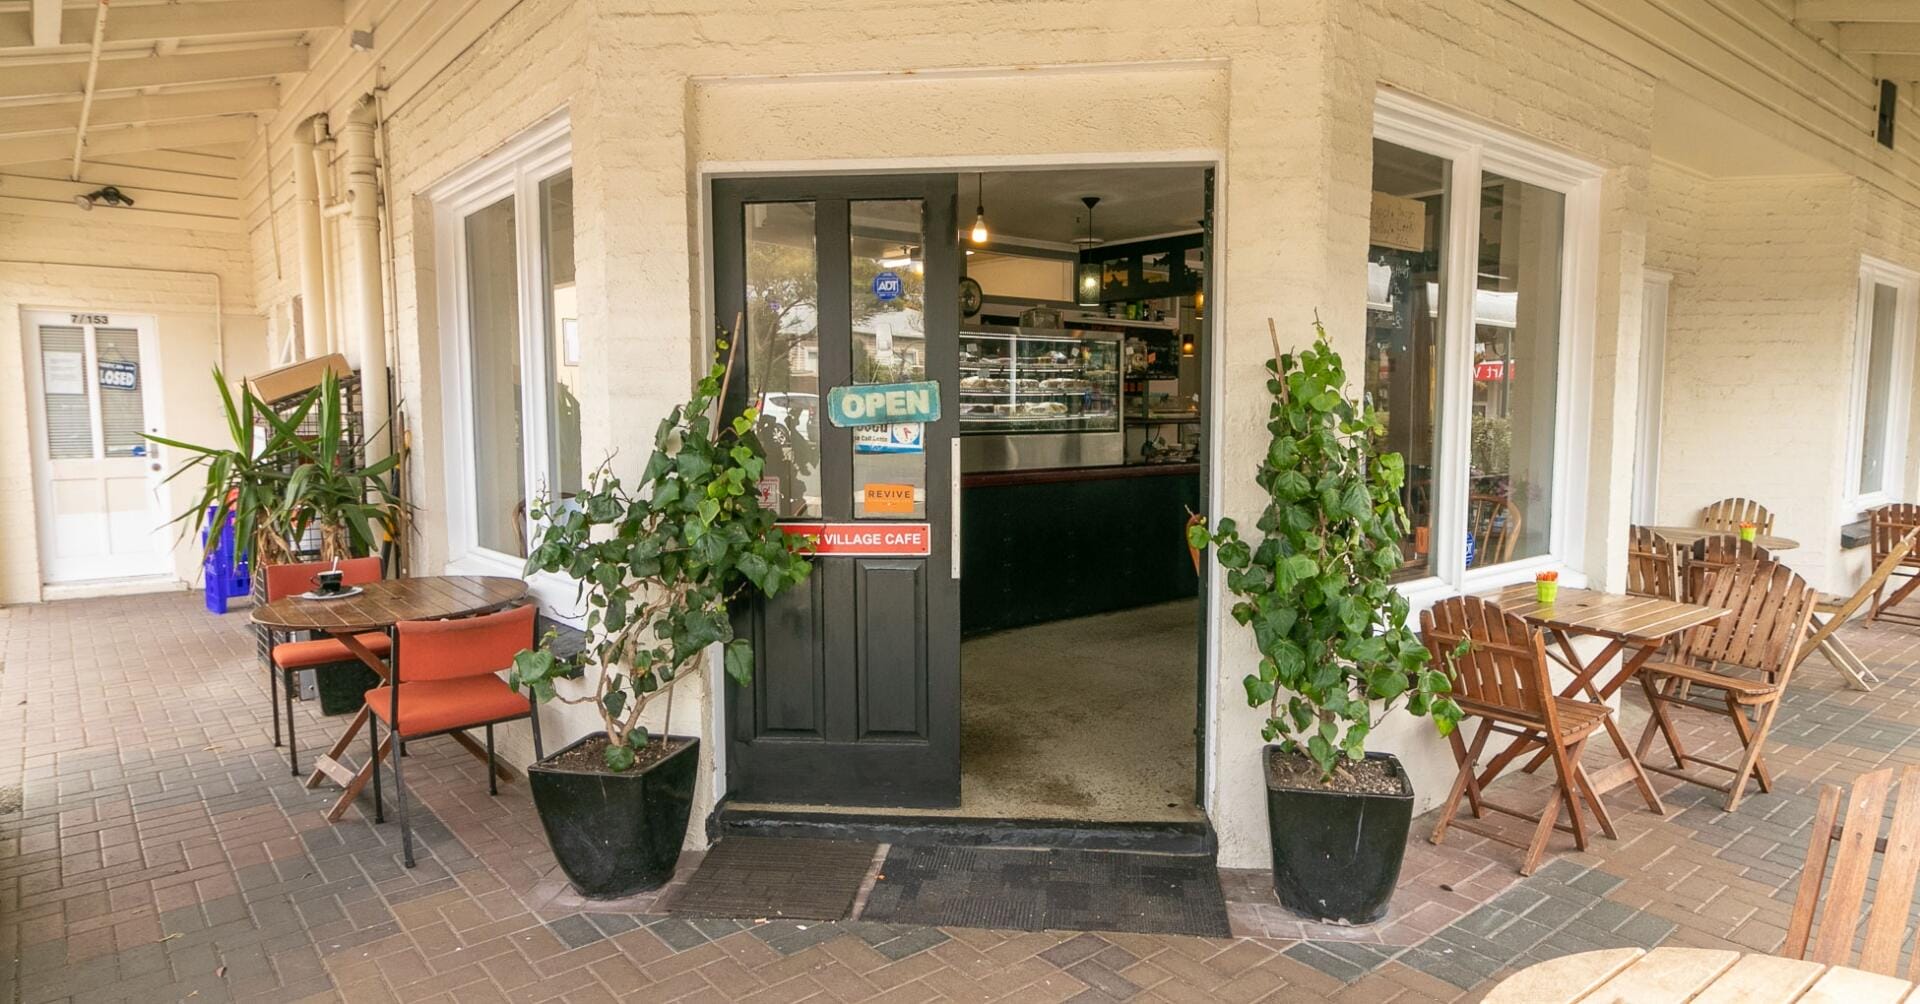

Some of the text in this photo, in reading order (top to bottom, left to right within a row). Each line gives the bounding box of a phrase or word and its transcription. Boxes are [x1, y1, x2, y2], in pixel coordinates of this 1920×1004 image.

[878, 280, 897, 291] ADT
[71, 314, 109, 325] 7/153
[99, 369, 135, 386] LOSED
[842, 389, 930, 419] OPEN
[868, 490, 911, 499] REVIVE
[824, 533, 882, 545] VILLAGE
[884, 533, 921, 545] CAFE
